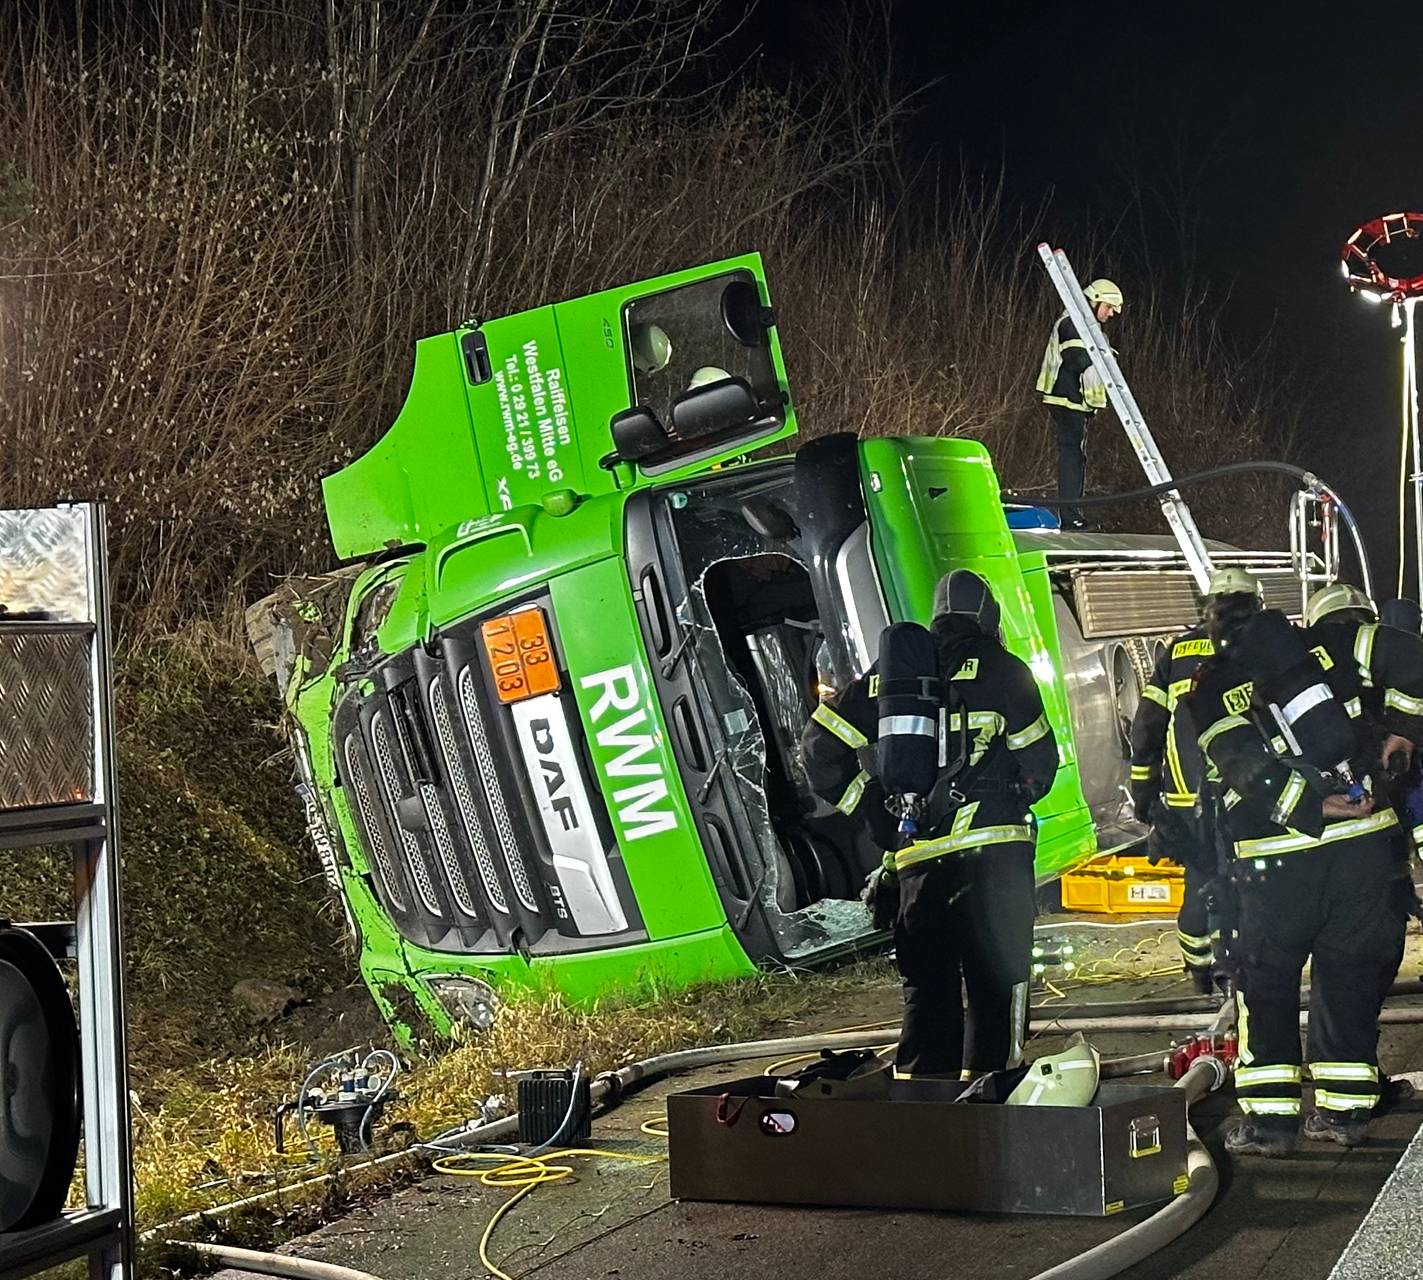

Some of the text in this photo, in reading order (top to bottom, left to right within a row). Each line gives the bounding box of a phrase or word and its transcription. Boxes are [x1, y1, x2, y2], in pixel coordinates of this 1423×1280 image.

[494, 369, 524, 470] www.rwm-eg.de
[522, 339, 563, 483] Westfalen Mitte eG
[546, 367, 571, 444] Raiffeisen
[486, 623, 524, 692] 1203
[520, 633, 550, 667] 33
[529, 717, 581, 832] DAF
[579, 663, 679, 842] RWM
